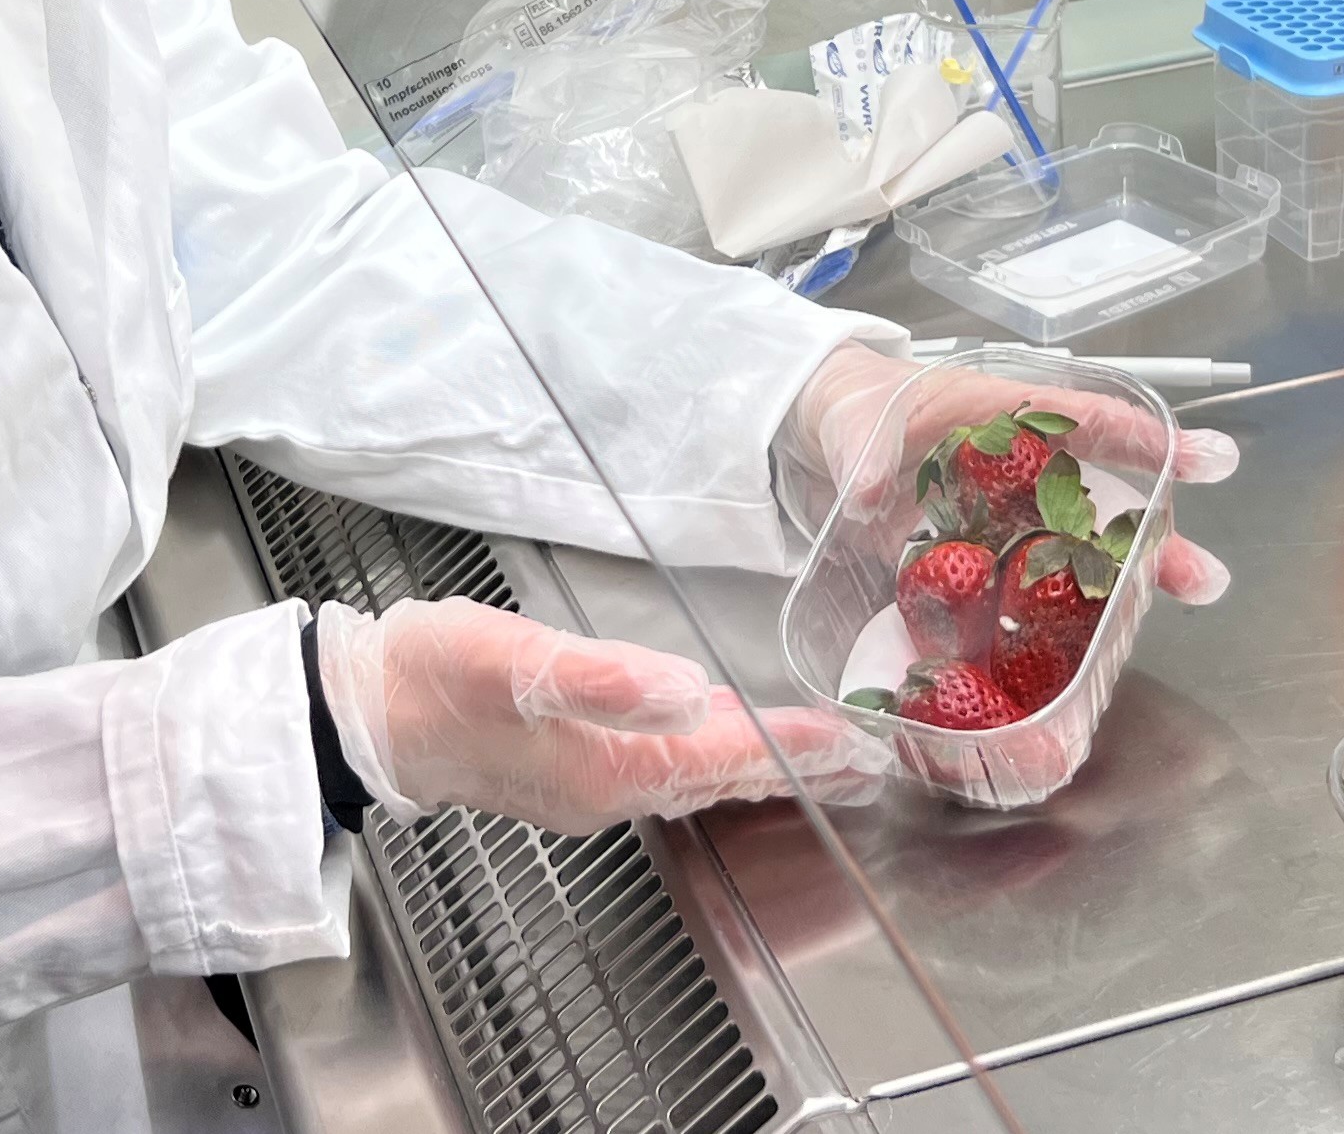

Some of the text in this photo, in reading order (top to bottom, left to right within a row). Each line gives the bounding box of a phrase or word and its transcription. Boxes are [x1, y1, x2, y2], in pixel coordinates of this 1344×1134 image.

[376, 77, 392, 92] 10
[383, 57, 466, 107] Impfschlingen
[389, 62, 494, 122] Inoculation loops
[859, 84, 873, 126] VWR
